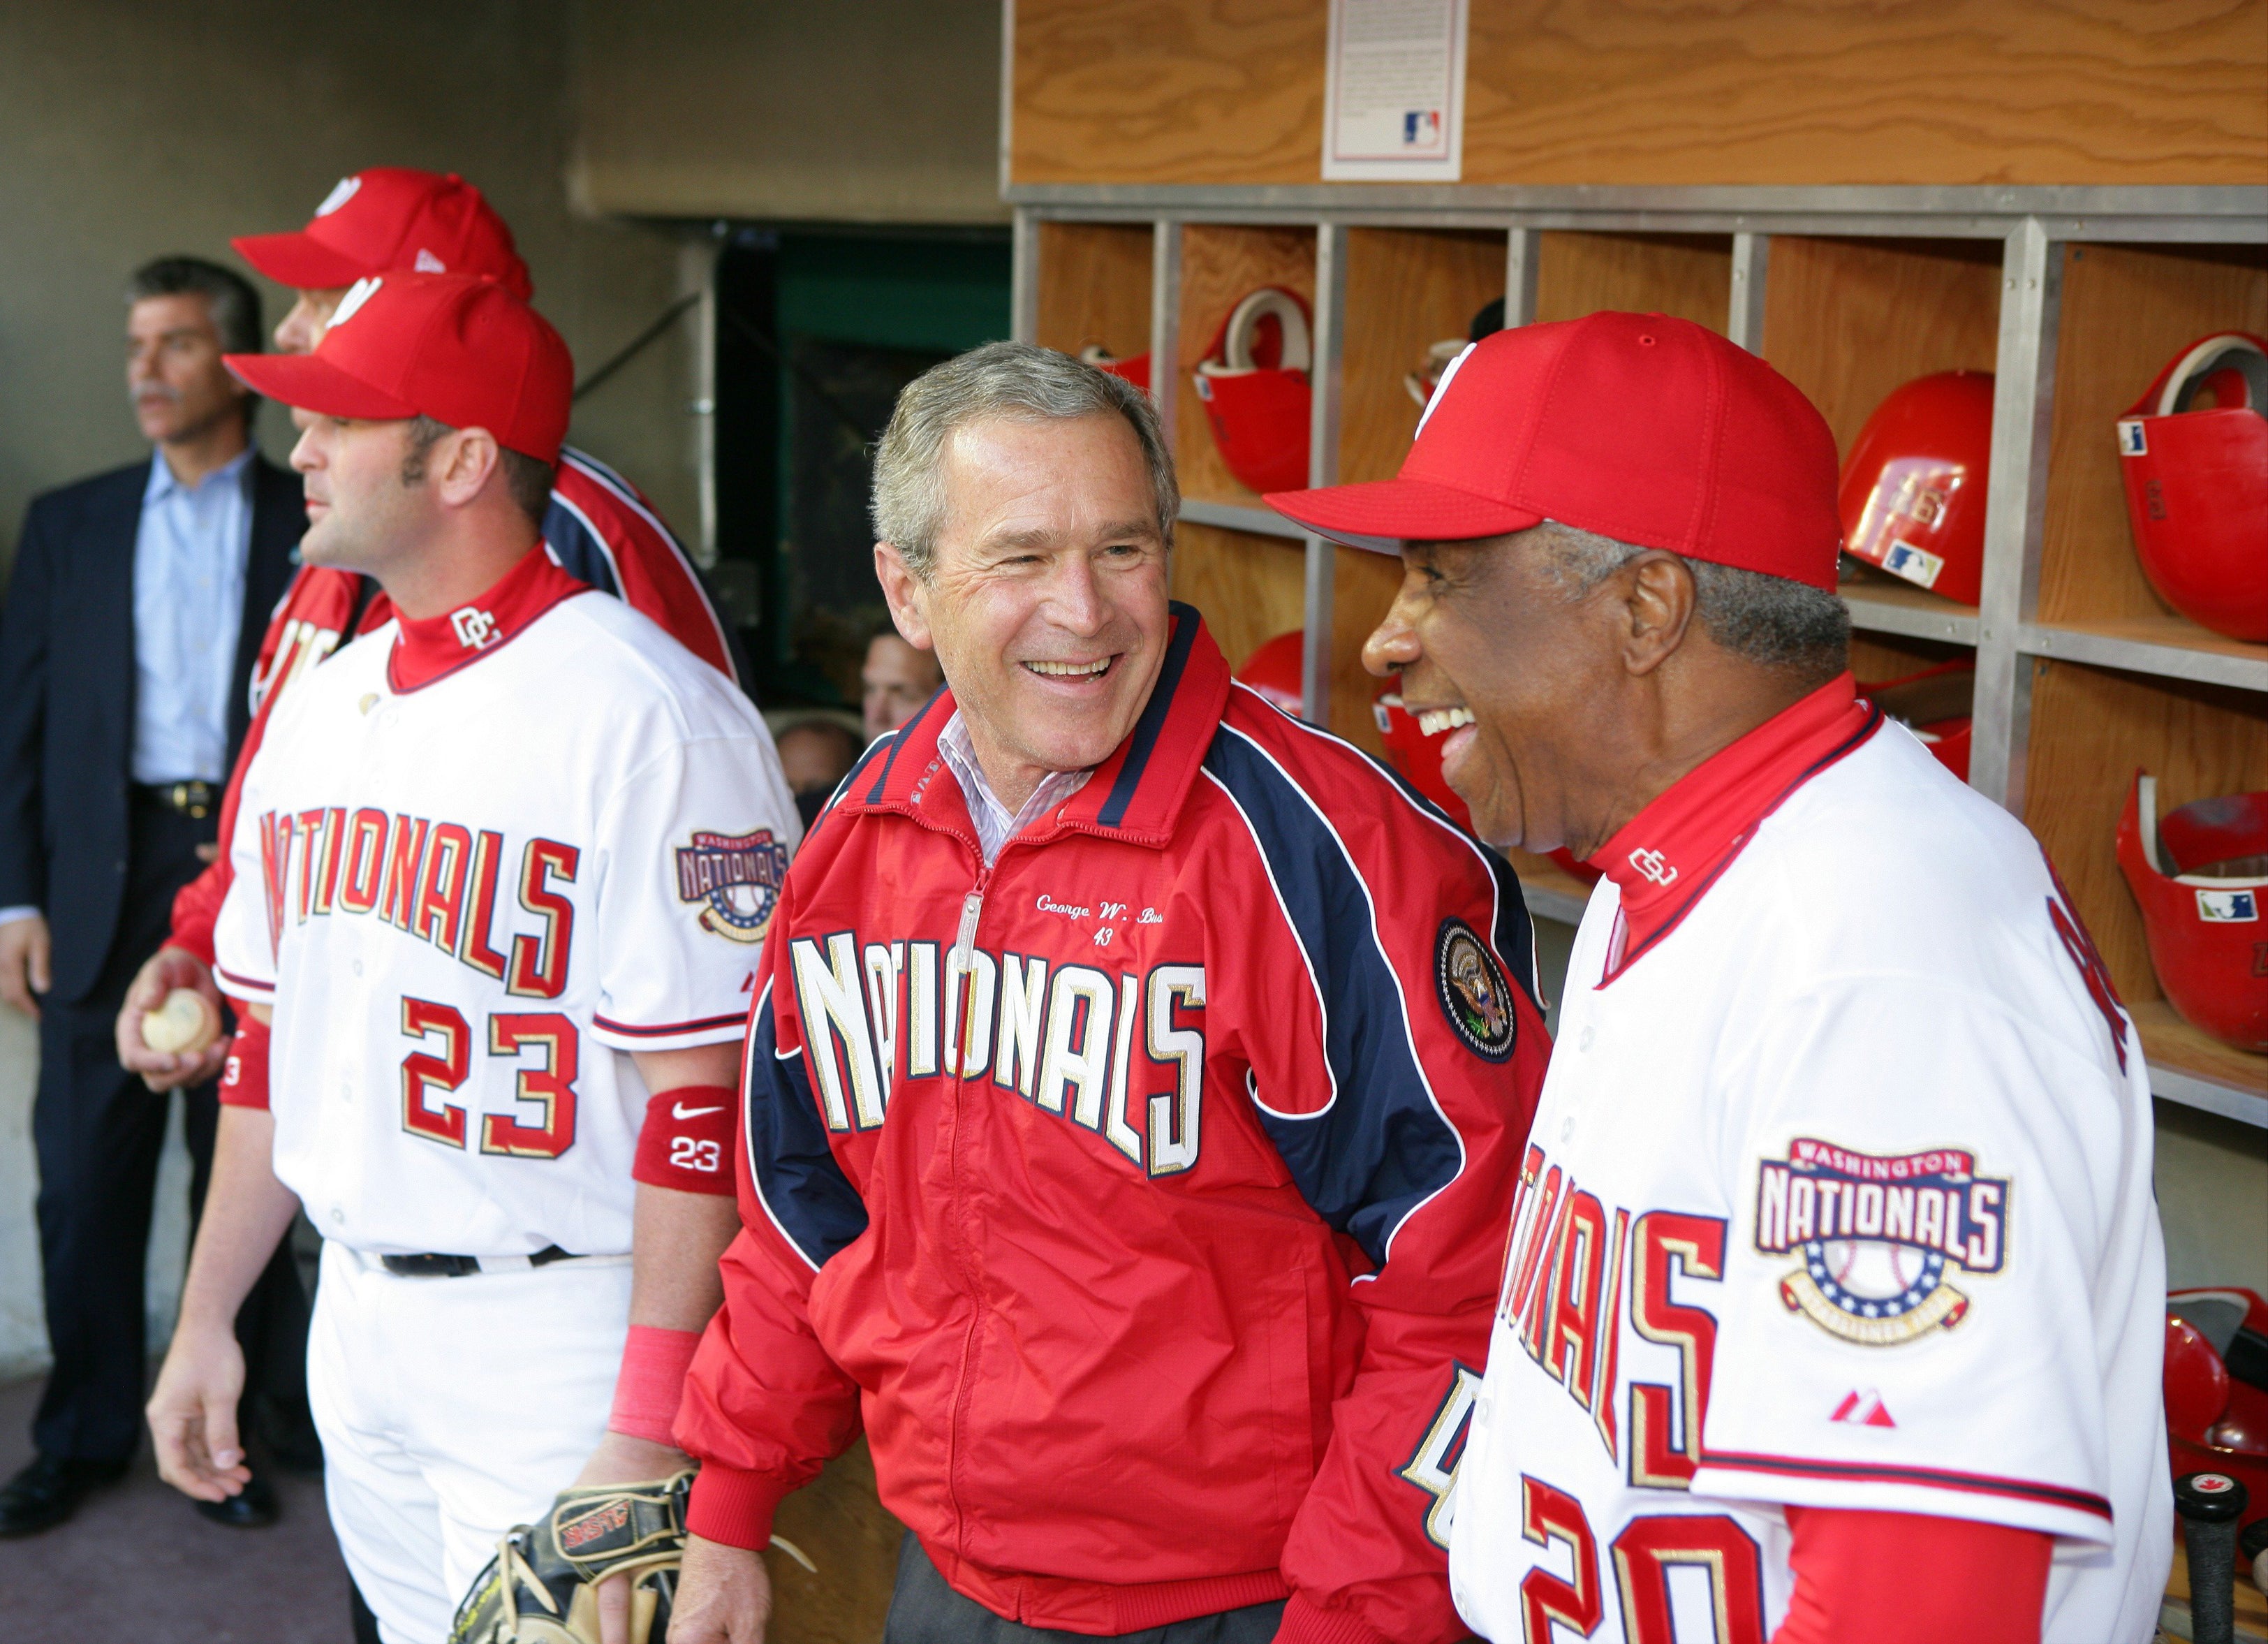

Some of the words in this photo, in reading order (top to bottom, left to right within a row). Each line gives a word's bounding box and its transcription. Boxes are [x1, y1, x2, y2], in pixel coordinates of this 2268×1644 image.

[259, 807, 581, 999] NATIONALS
[1037, 894, 1090, 920] George
[1099, 901, 1128, 921] W.
[1094, 927, 1114, 946] 43
[402, 995, 579, 1159] 23
[670, 1136, 721, 1173] 23
[1796, 1141, 1963, 1178] WASHINGTON
[1758, 1165, 2001, 1270] NATIONALS
[1520, 1472, 1768, 1644] 20
